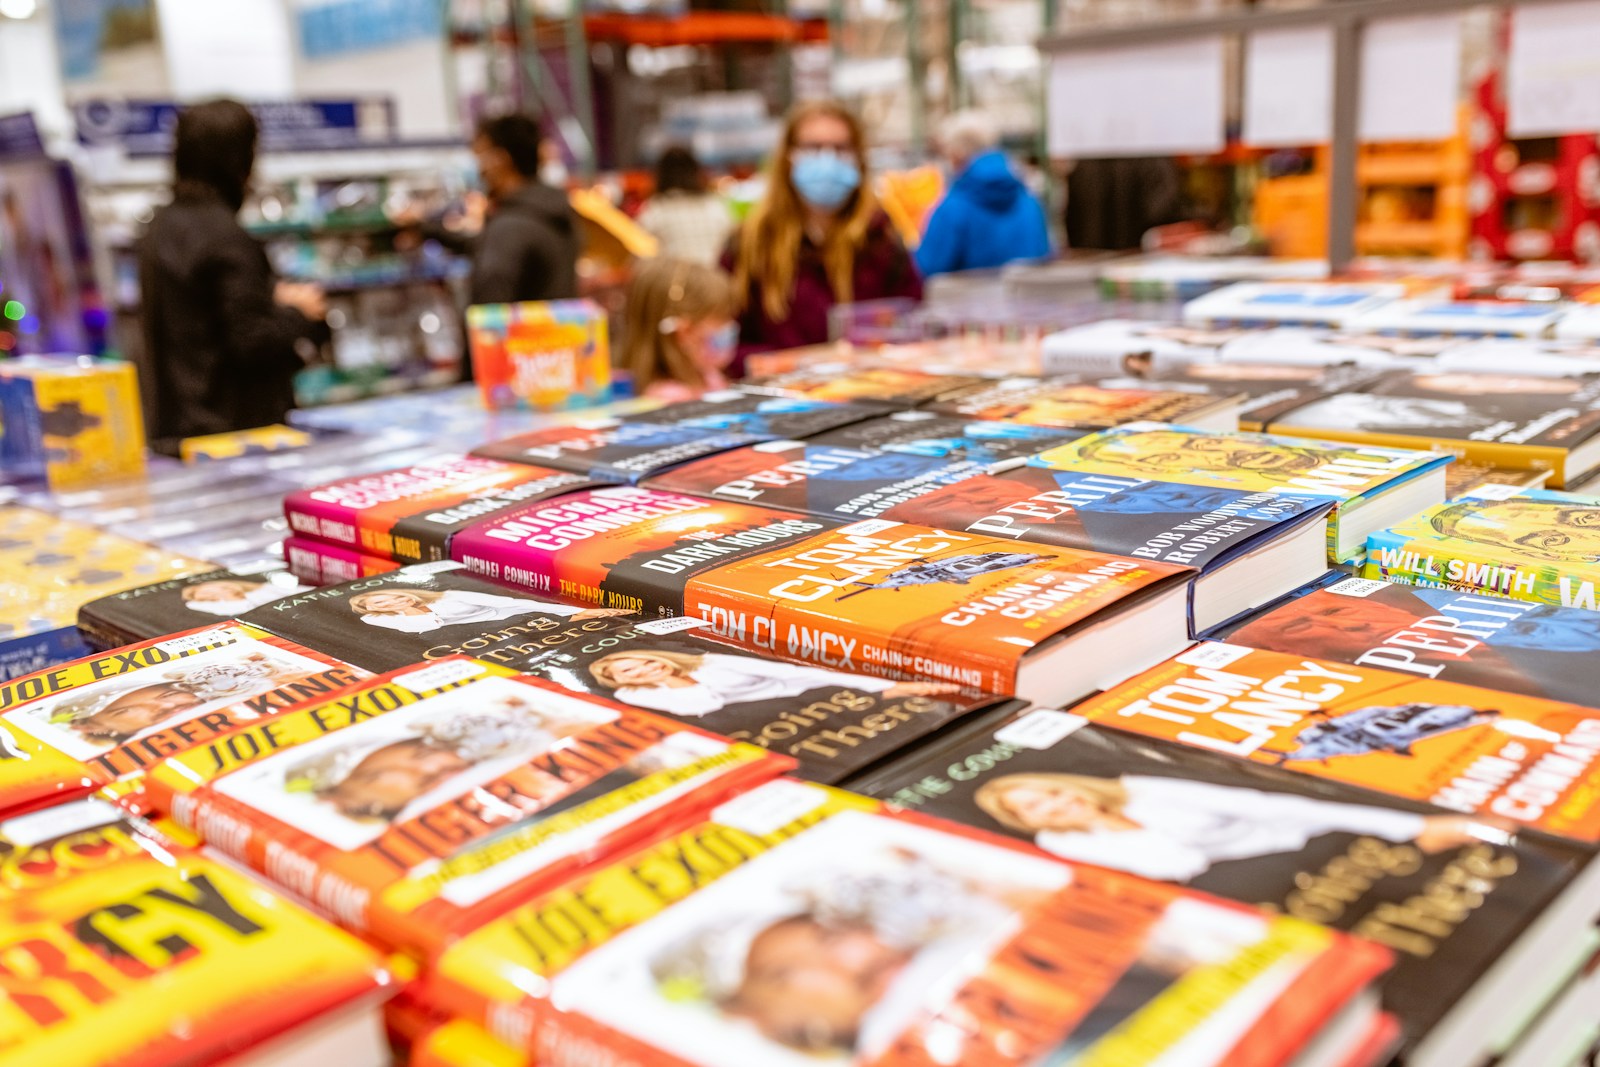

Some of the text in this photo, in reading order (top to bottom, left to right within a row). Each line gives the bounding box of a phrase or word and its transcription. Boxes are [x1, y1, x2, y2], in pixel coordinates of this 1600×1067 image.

[712, 449, 883, 500] PERIL
[485, 485, 675, 543] MICHAEL
[526, 494, 713, 551] CONNELLY
[834, 493, 883, 514] BOB
[965, 476, 1153, 539] PERIL
[1131, 492, 1281, 559] BOB WOODWARD
[640, 542, 741, 575] DARK
[717, 519, 823, 553] HOURS
[678, 530, 725, 542] THE
[764, 533, 894, 570] TOM
[1164, 519, 1248, 564] ROBERT
[559, 579, 577, 597] THE
[769, 529, 973, 602] CLANCY
[1000, 561, 1140, 619] COMMAND
[1381, 546, 1536, 594] WILL SMITH
[1386, 575, 1411, 585] with
[1415, 579, 1458, 591] MARK
[273, 588, 344, 612] KATIE
[941, 583, 1042, 626] CHAIN
[422, 616, 560, 660] Going
[477, 619, 609, 662] There
[697, 602, 746, 642] TOM
[862, 645, 903, 667] CHAIN
[914, 657, 982, 686] COMMAND
[1354, 596, 1545, 679] PERIL
[0, 669, 74, 709] JOE
[1117, 668, 1263, 725] TOM
[1176, 660, 1364, 757] LANCY
[96, 669, 361, 777] TIGER KING
[206, 724, 288, 771] JOE
[790, 697, 937, 758] There
